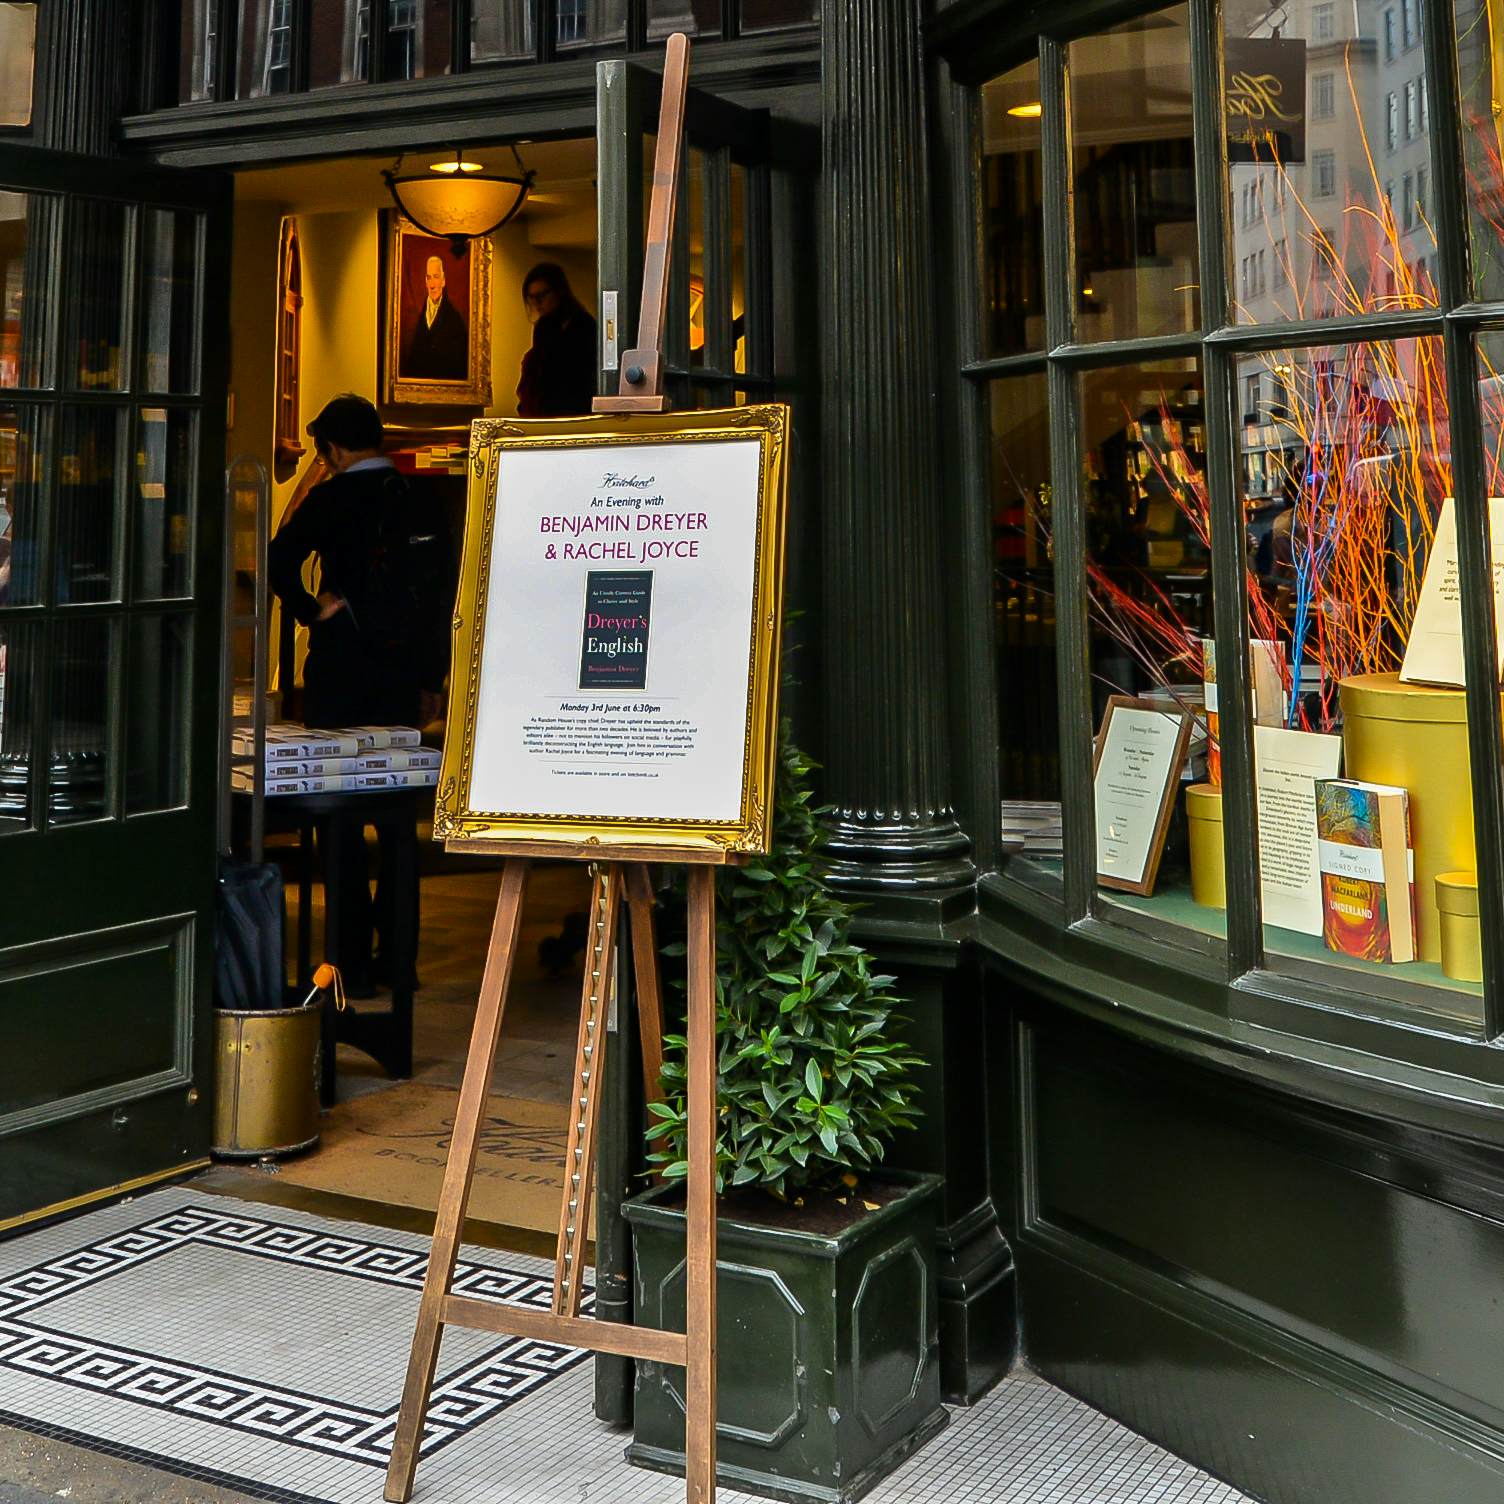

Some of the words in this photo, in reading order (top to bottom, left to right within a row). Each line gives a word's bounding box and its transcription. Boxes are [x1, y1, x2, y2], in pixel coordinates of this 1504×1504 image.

[591, 497, 603, 507] An
[606, 496, 641, 509] Evening
[645, 495, 664, 507] with
[540, 515, 630, 537] BENJAMIN
[636, 513, 708, 531] DREYER
[545, 543, 557, 559] &
[564, 542, 636, 559] RACHEL
[640, 541, 699, 563] JOYCE
[588, 614, 647, 633] Dreyer's
[587, 636, 643, 658] English
[560, 704, 589, 713] Monday
[591, 704, 603, 712] 3rd
[605, 704, 620, 713] June
[632, 704, 661, 713] 6:30pm
[1330, 901, 1373, 919] UNDERLAND
